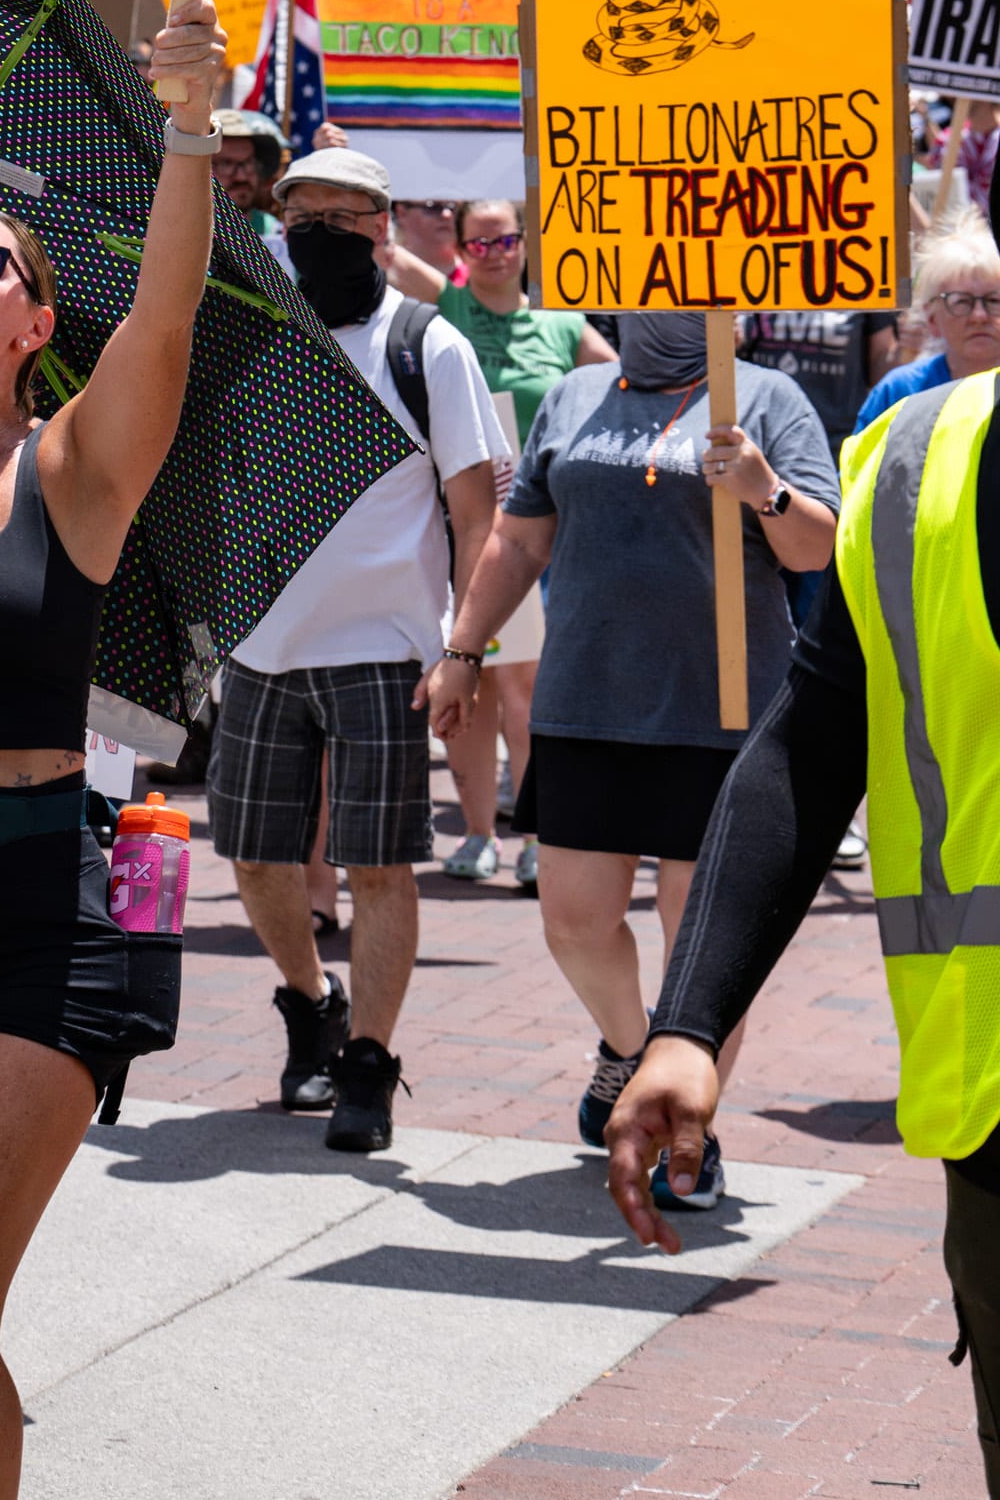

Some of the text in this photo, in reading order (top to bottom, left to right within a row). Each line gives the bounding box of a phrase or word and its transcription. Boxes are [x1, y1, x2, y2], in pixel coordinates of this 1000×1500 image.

[326, 23, 423, 56] TACO
[547, 89, 880, 167] BILLIONAIRES
[542, 162, 876, 238] ARE TREADING
[556, 236, 892, 307] ON ALL OF US!
